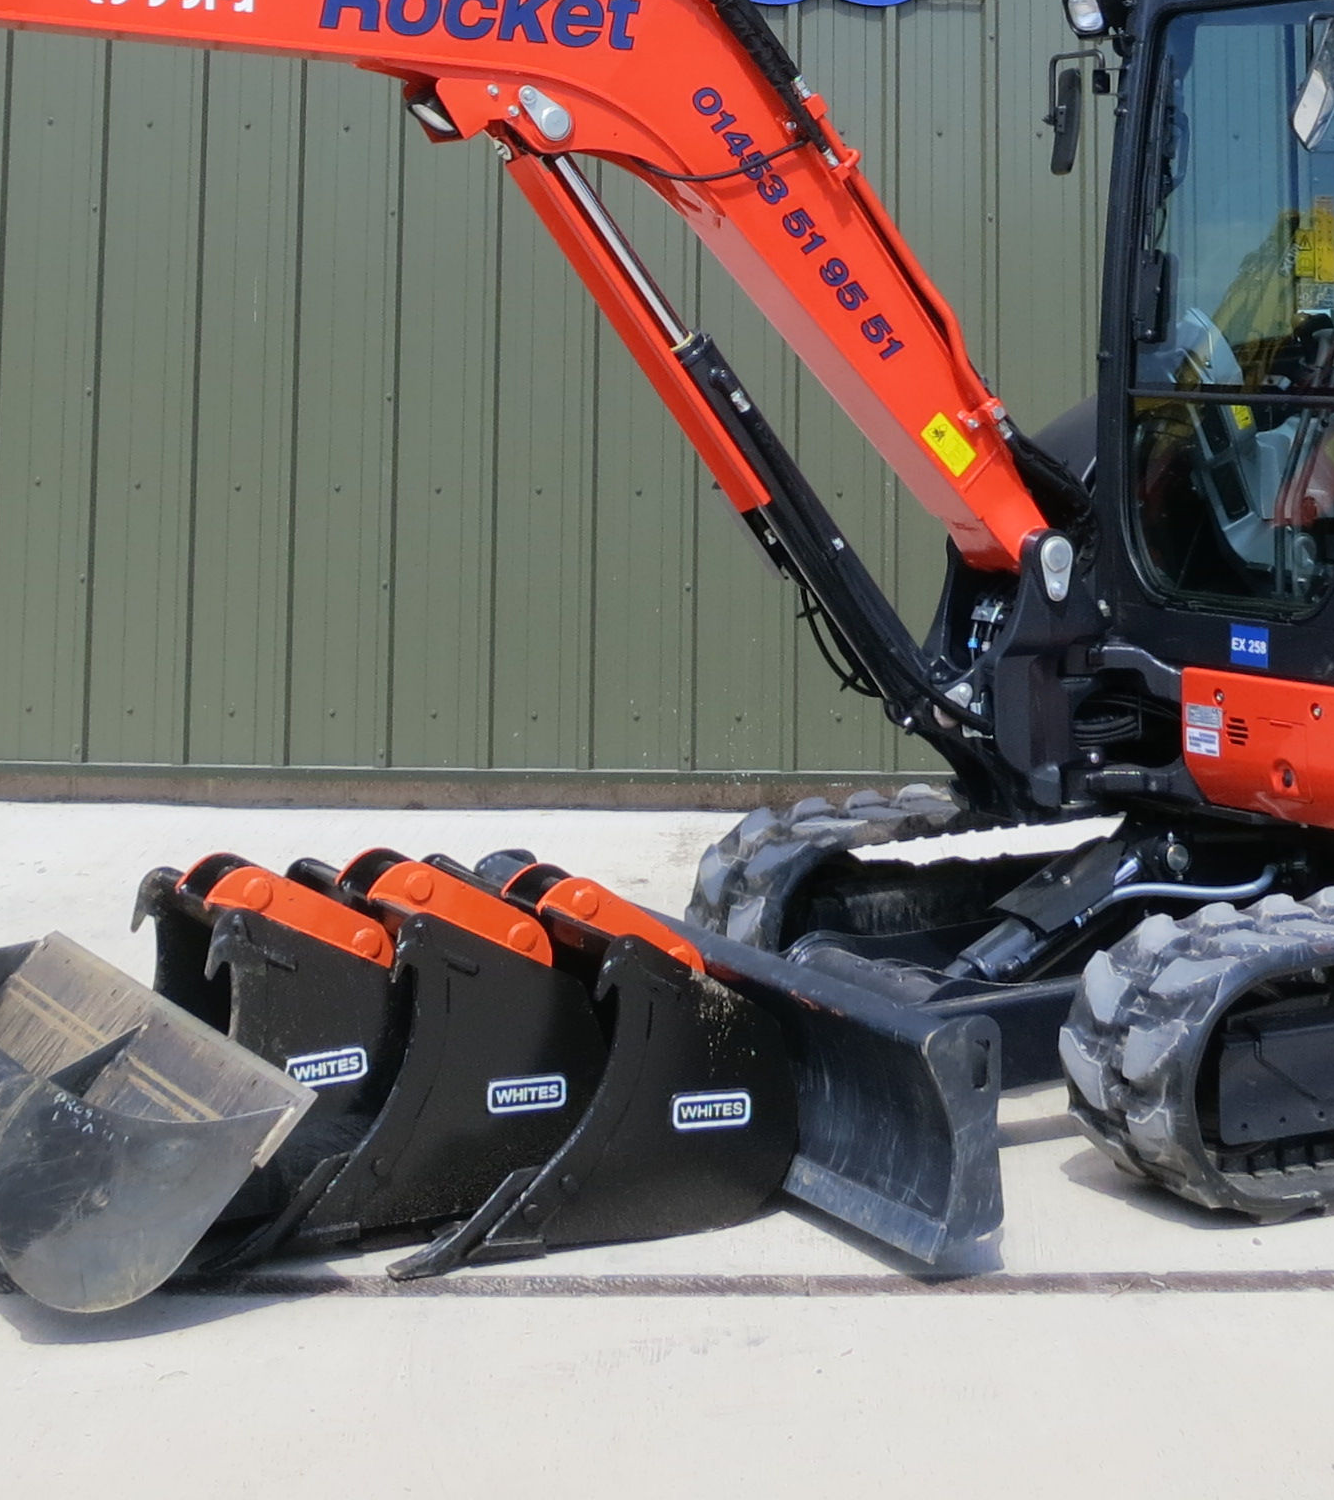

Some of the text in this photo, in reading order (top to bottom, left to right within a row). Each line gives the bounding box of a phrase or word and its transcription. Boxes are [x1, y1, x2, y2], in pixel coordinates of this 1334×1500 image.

[692, 87, 905, 360] 01453 51 95 51
[1231, 636, 1246, 652] EX
[293, 1055, 361, 1082] WHITES
[495, 1083, 560, 1105] WHITES
[680, 1101, 744, 1120] WHITES
